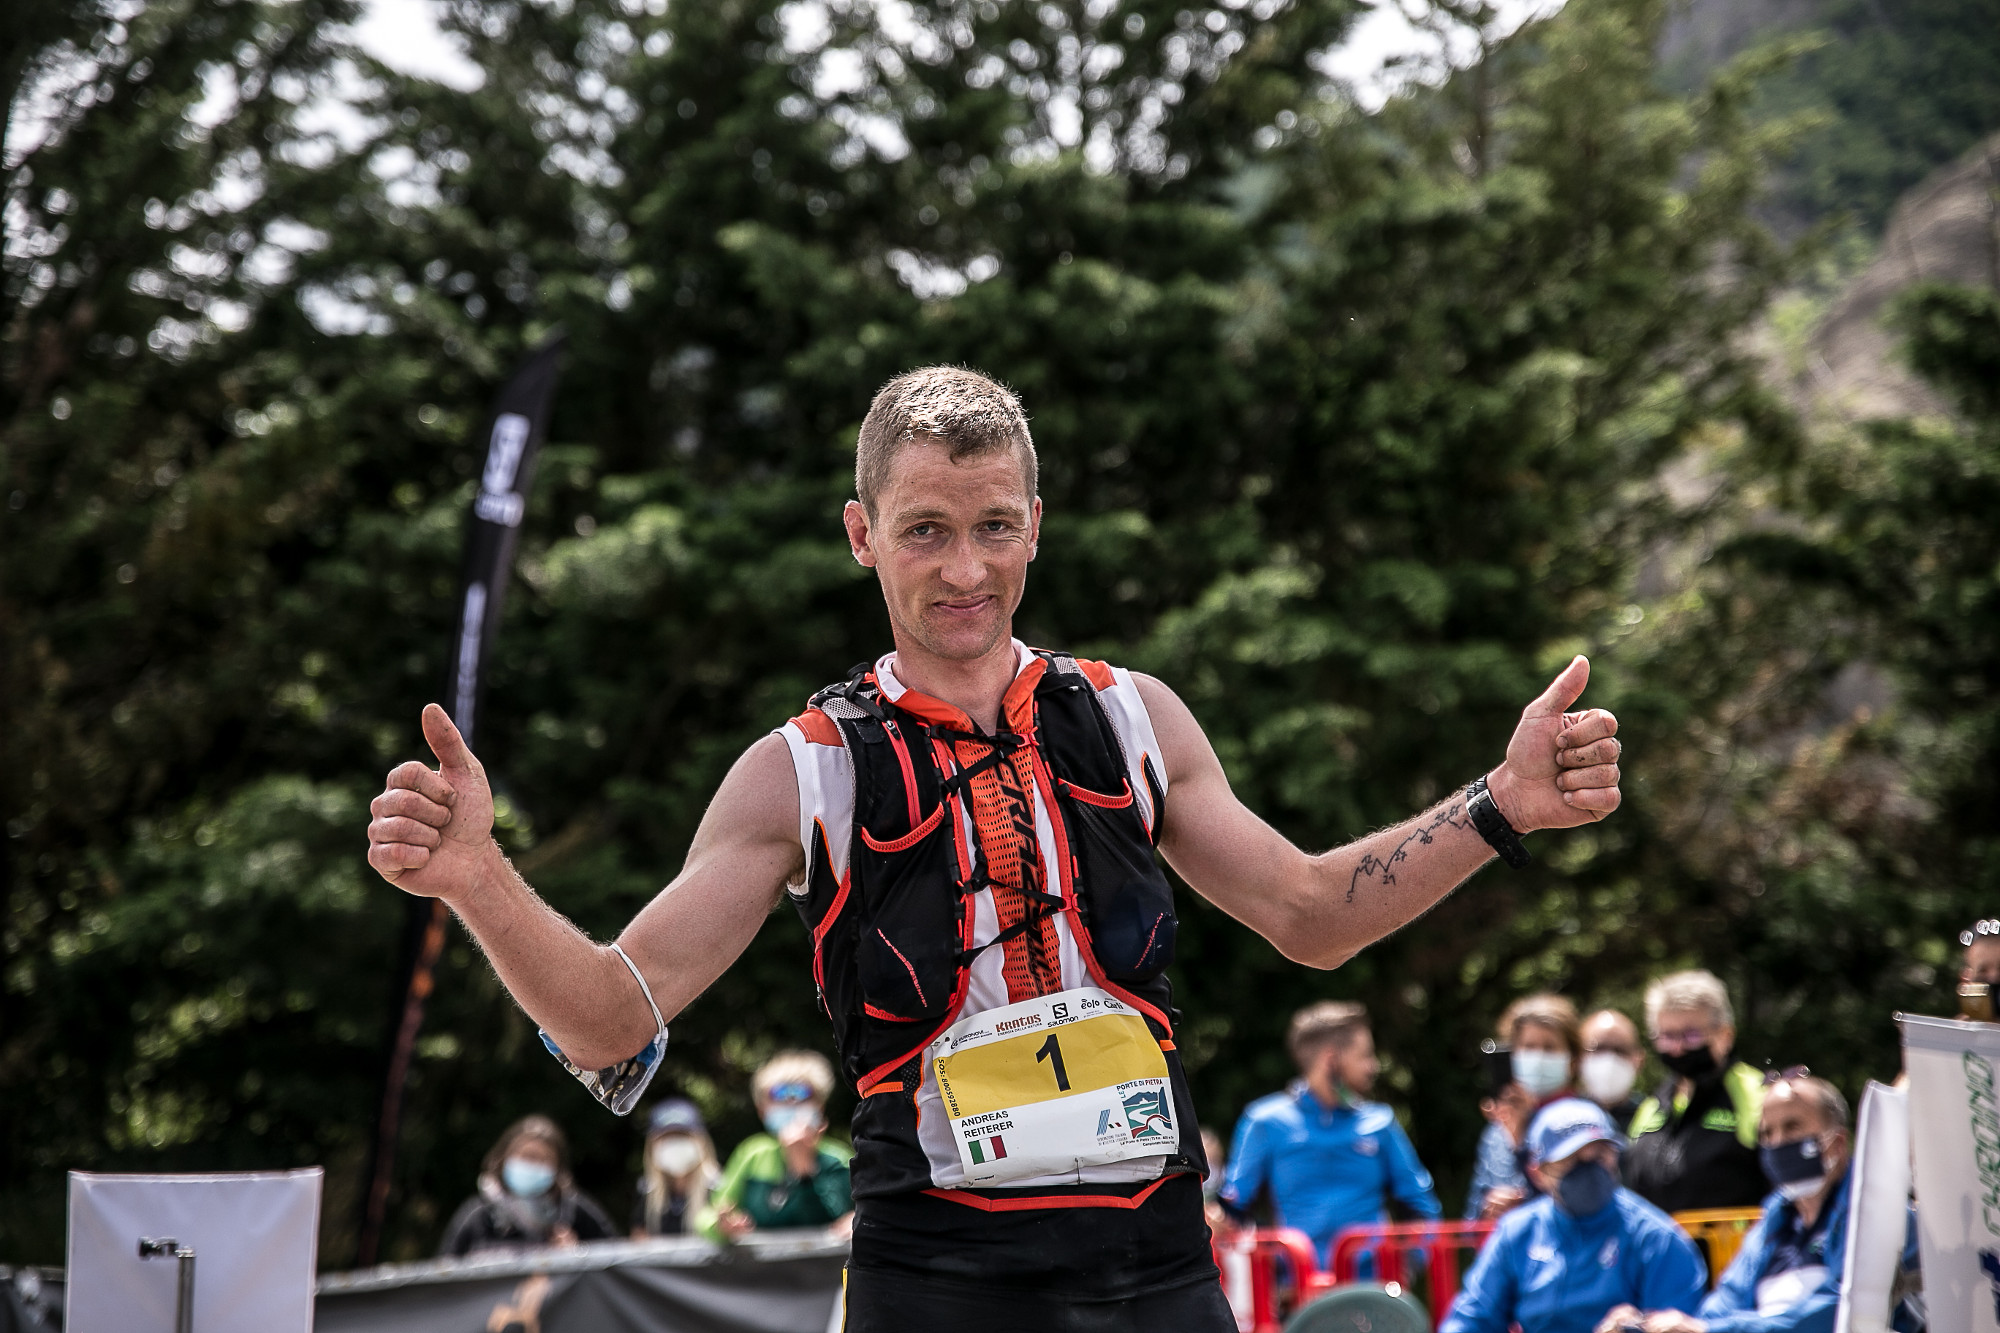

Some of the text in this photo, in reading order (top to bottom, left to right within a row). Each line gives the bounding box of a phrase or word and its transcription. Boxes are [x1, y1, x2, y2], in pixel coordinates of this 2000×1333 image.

[1036, 1033, 1071, 1092] 1
[938, 1059, 961, 1117] SOS: 800592880
[1116, 1082, 1138, 1091] PORTE
[961, 1111, 1009, 1127] ANDREAS
[963, 1120, 1014, 1138] REITERER
